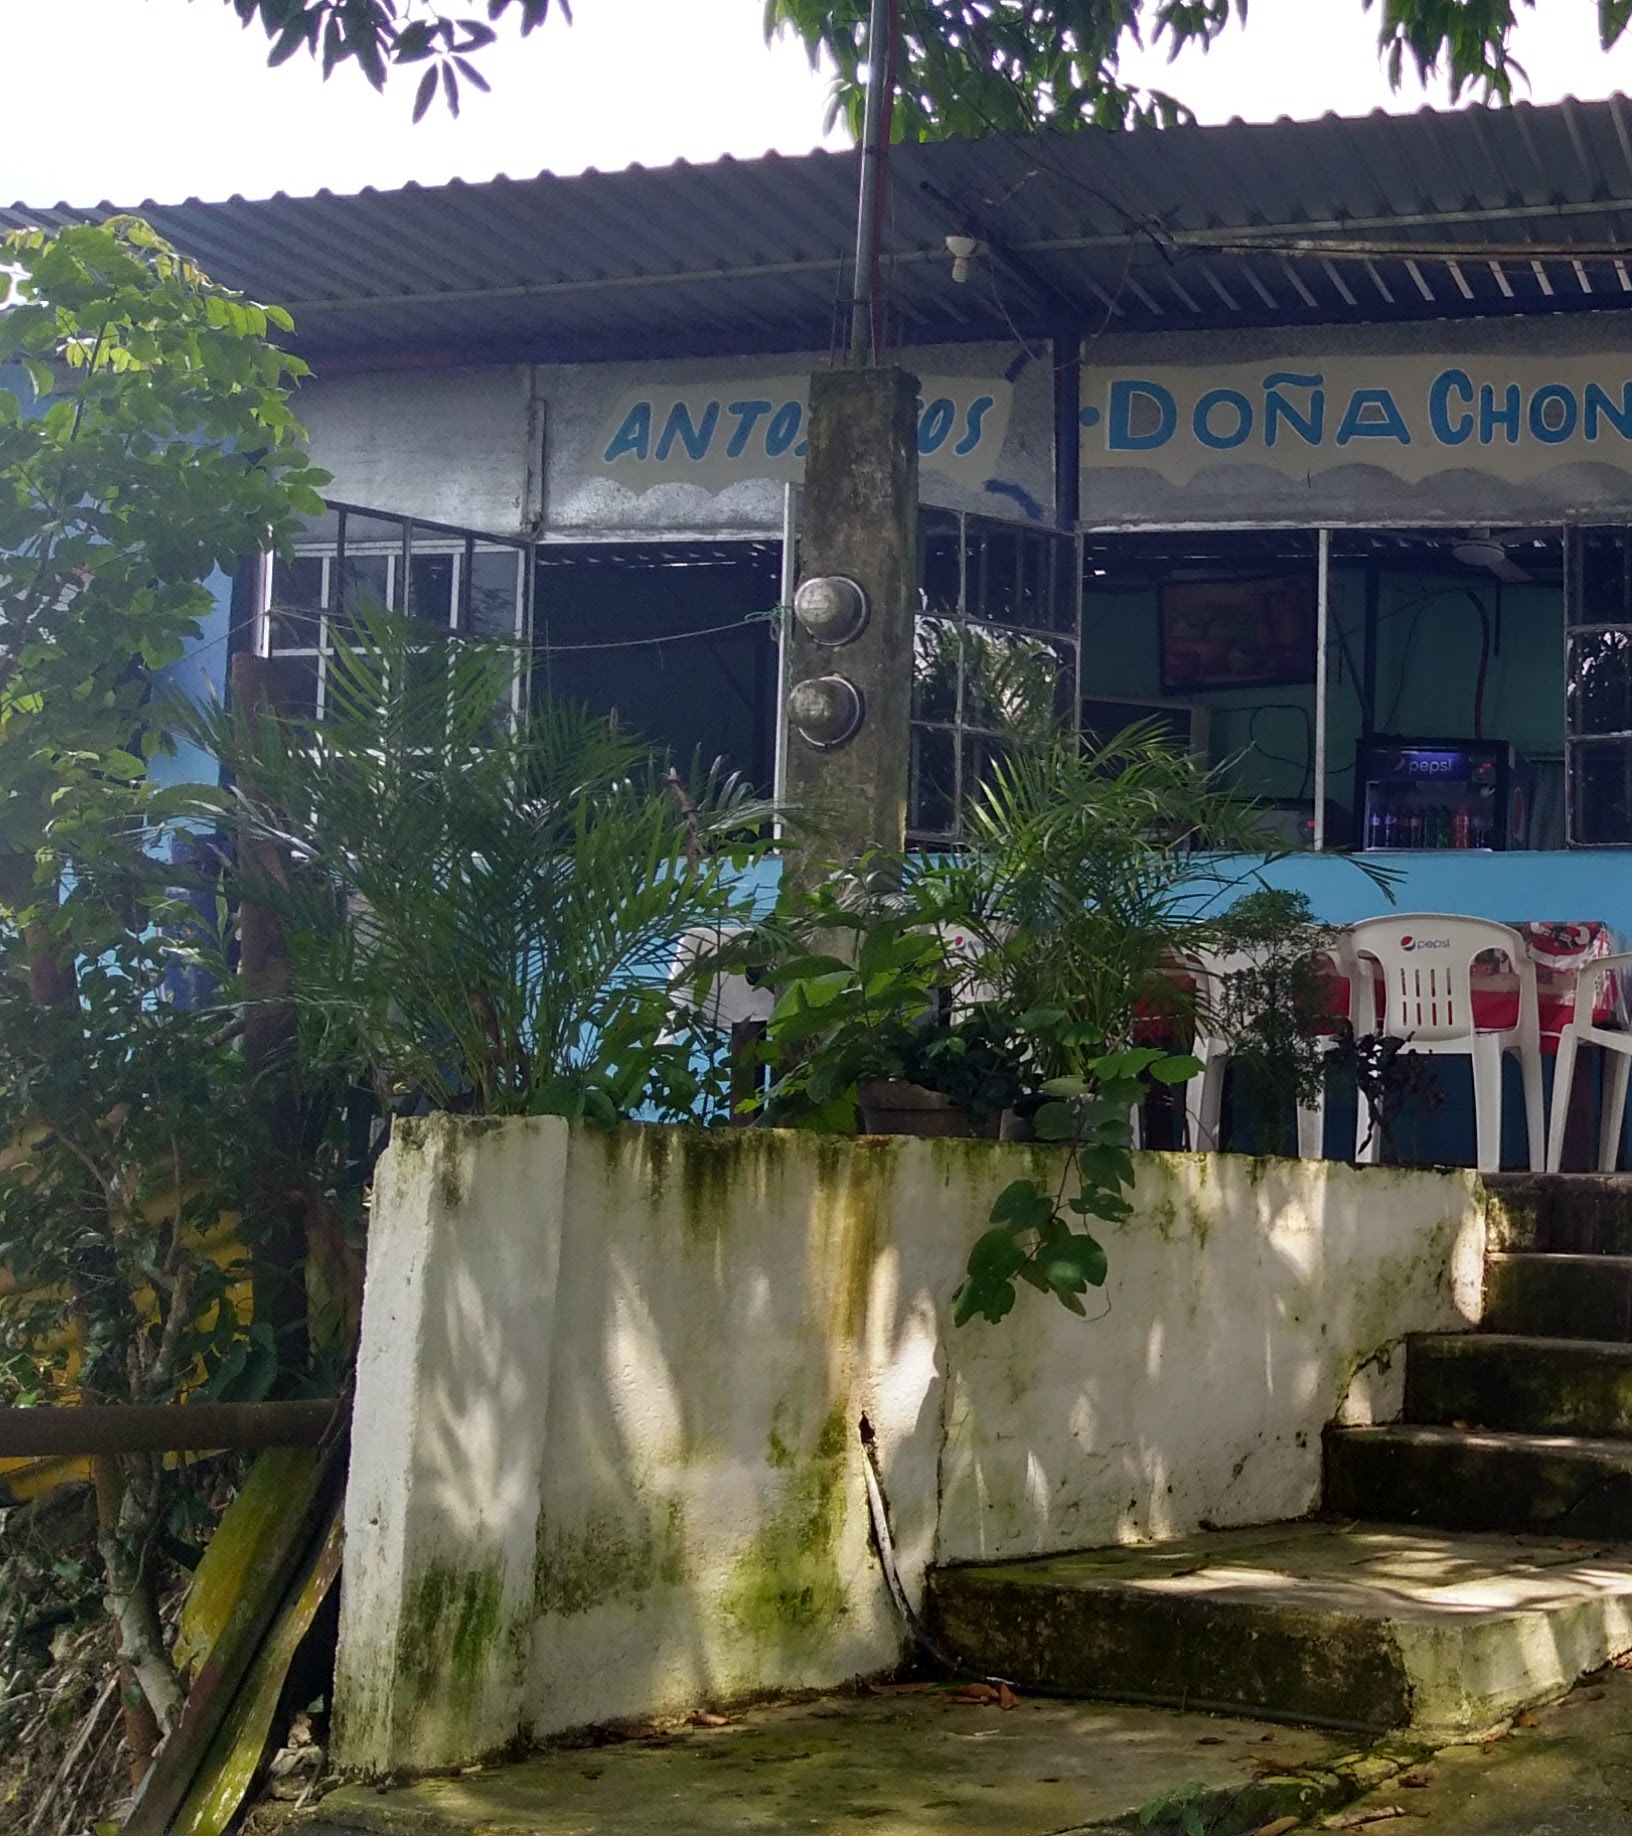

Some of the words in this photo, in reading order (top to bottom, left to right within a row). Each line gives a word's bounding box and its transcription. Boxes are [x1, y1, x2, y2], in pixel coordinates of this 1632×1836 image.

[602, 397, 995, 463] ANTOOS
[1107, 372, 1412, 450] DOÑA
[1408, 758, 1453, 775] pepsi
[1417, 938, 1450, 950] pepsi
